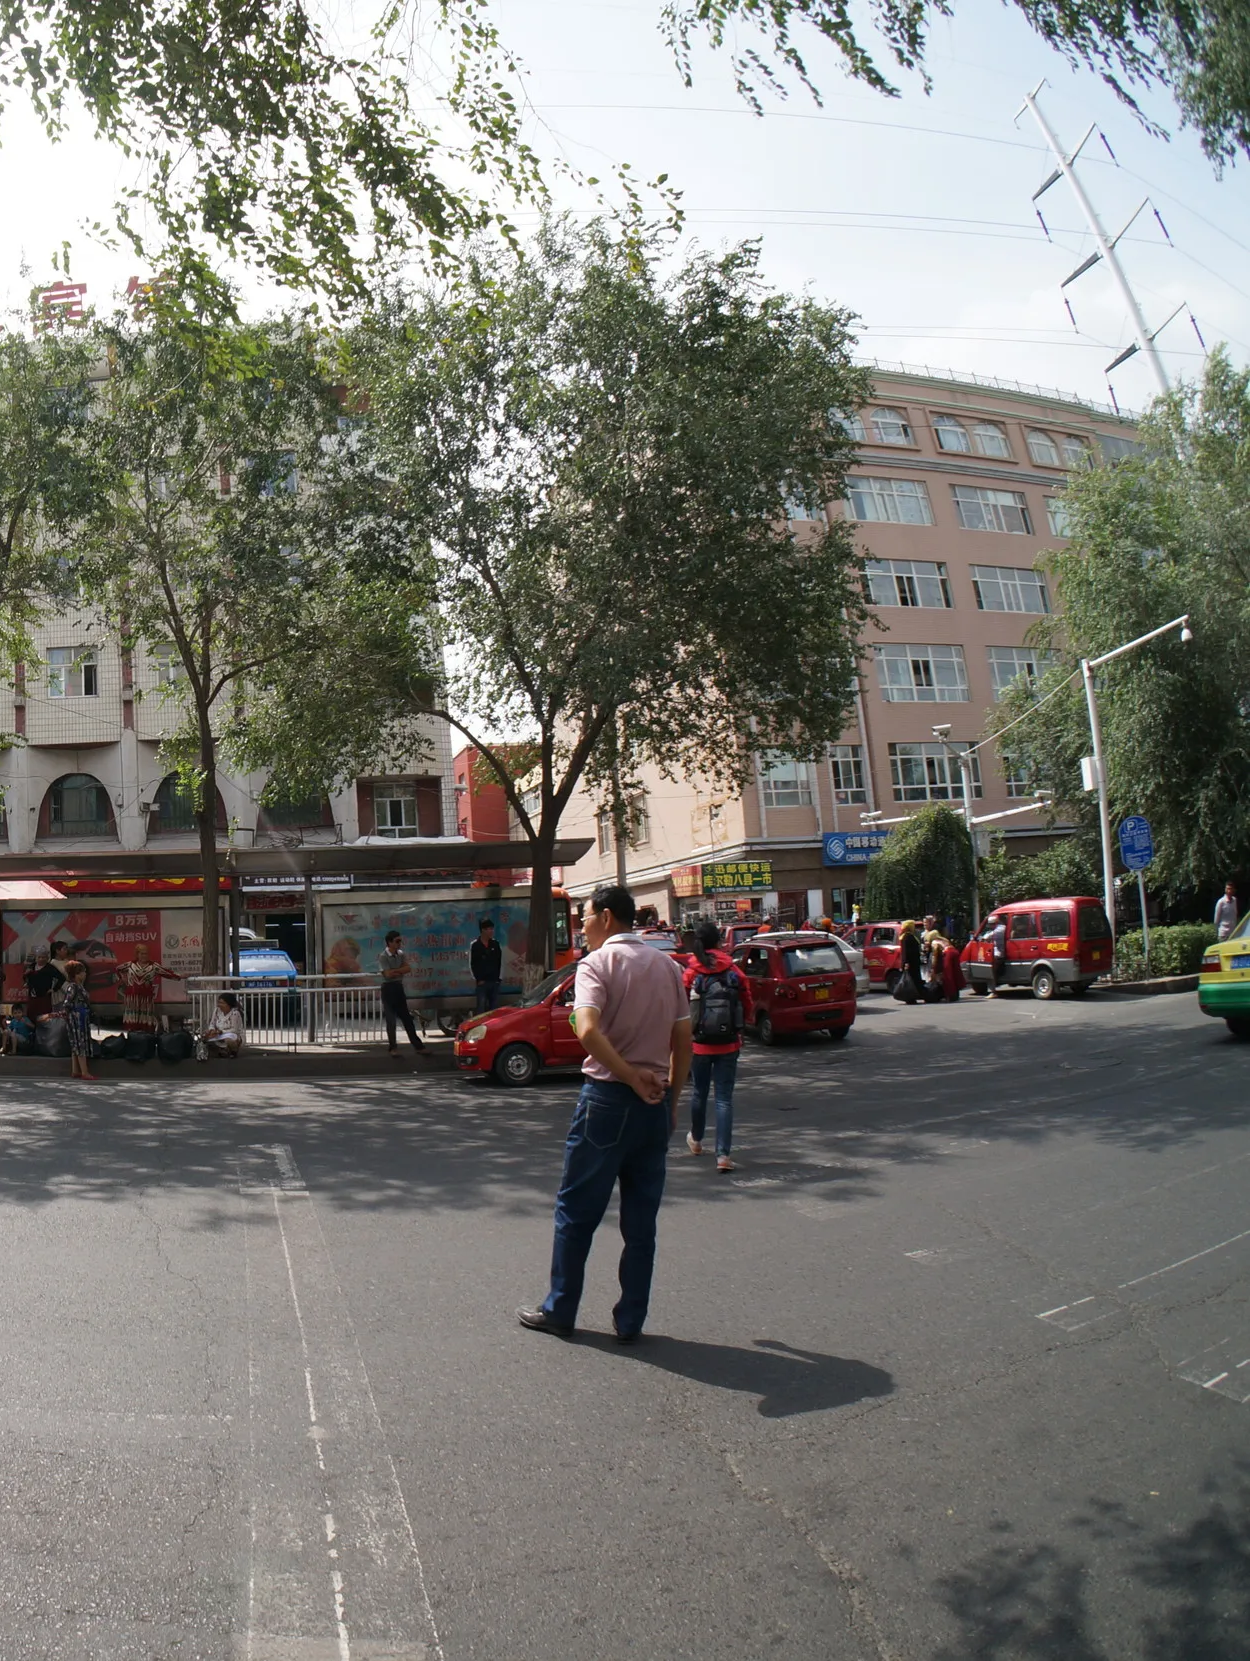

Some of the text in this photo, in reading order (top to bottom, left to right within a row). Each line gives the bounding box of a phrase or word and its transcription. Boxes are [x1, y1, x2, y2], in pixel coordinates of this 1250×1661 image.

[703, 873, 772, 887] 库尔勒八县一市
[115, 914, 148, 926] 8万元
[105, 932, 157, 943] 自动挡SUV
